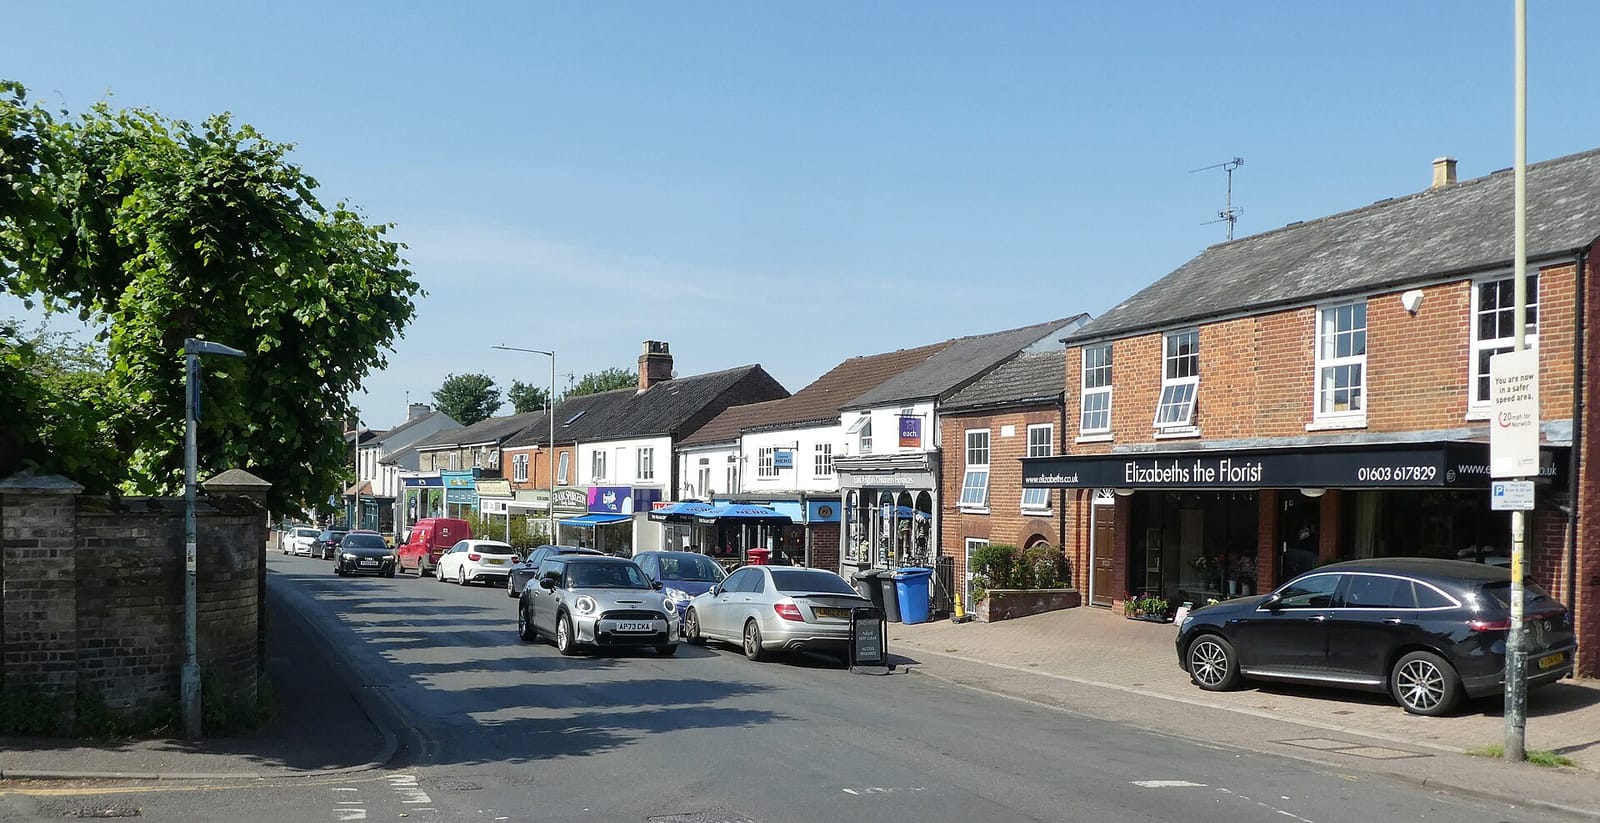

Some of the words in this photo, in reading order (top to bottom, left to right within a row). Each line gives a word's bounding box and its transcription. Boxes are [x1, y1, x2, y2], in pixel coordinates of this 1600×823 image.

[1495, 376, 1506, 385] You
[1512, 383, 1529, 392] safer
[1496, 395, 1515, 405] speed
[1125, 460, 1190, 483] Elizabeths
[1192, 460, 1214, 482] the
[1219, 458, 1262, 482] Florist
[1358, 467, 1391, 481] 01603
[1394, 466, 1436, 480] 617829
